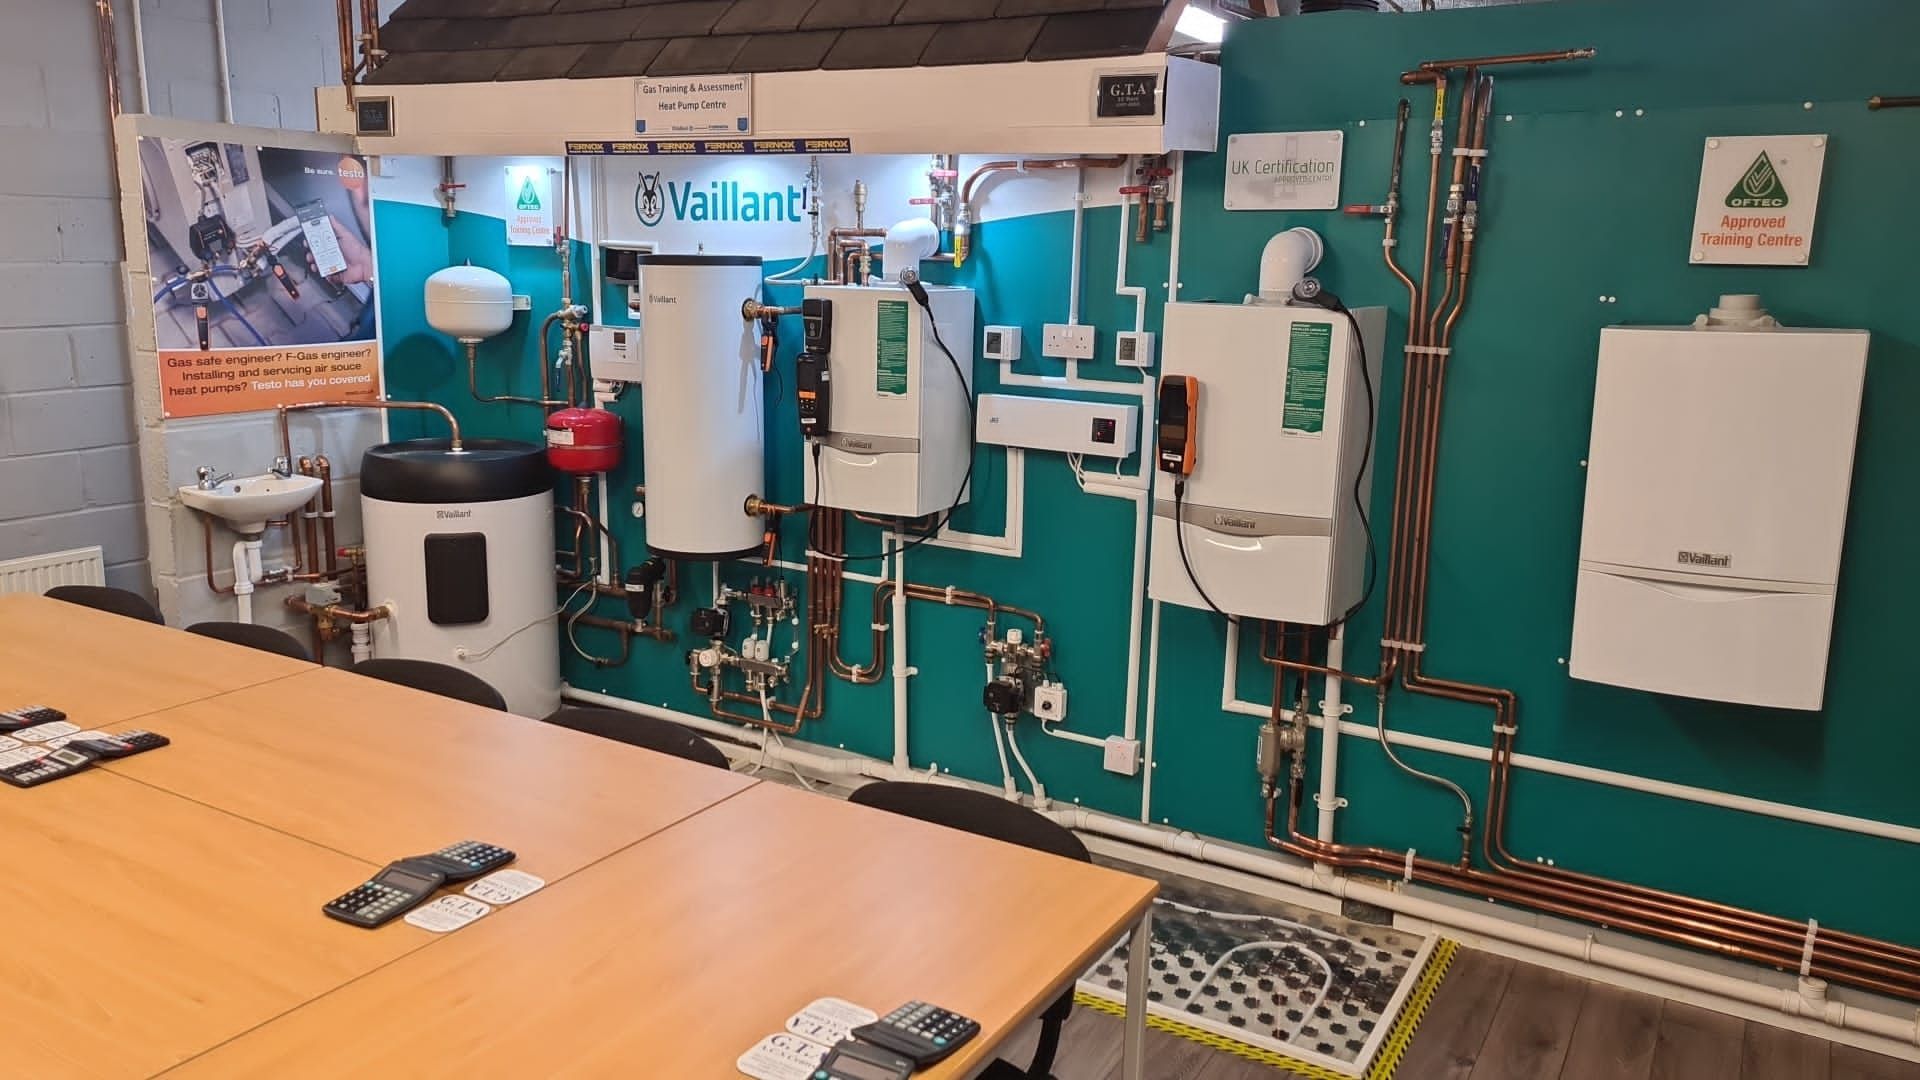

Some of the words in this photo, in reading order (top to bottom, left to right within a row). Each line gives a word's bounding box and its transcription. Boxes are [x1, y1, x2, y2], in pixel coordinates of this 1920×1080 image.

[642, 84, 657, 94] Gas
[658, 83, 688, 95] Training
[689, 83, 697, 92] &
[698, 82, 743, 93] Assessment
[1110, 82, 1146, 97] G.T.A
[658, 101, 676, 111] Heat
[678, 101, 700, 111] Pump
[701, 100, 727, 110] Centre
[567, 143, 604, 151] FERNOX
[612, 142, 649, 150] FERNOX
[656, 142, 697, 150] FERNOX
[704, 141, 744, 150] FERNOX
[753, 140, 796, 149] FERNOX
[805, 140, 848, 148] FERNOX
[338, 167, 365, 178] testo
[1231, 160, 1250, 175] UK
[1255, 159, 1335, 175] Certification
[667, 181, 802, 223] Vaillant
[1731, 198, 1783, 207] OFTEC
[1720, 215, 1787, 231] Approved
[1700, 232, 1754, 249] Training
[1757, 232, 1803, 247] Centre
[167, 358, 193, 368] Gas
[196, 355, 222, 367] safe
[225, 353, 282, 367] engineer?
[286, 352, 319, 362] F-Gas
[321, 348, 372, 361] engineer?
[182, 369, 236, 382] Installing
[238, 367, 260, 378] and
[263, 364, 312, 378] servicing
[314, 363, 328, 373] air
[331, 361, 362, 372] souce
[169, 385, 198, 397] heat
[201, 381, 248, 397] pumps?
[251, 379, 281, 391] Testo
[284, 376, 305, 388] has
[307, 376, 327, 388] you
[1689, 551, 1730, 567] Vaillant
